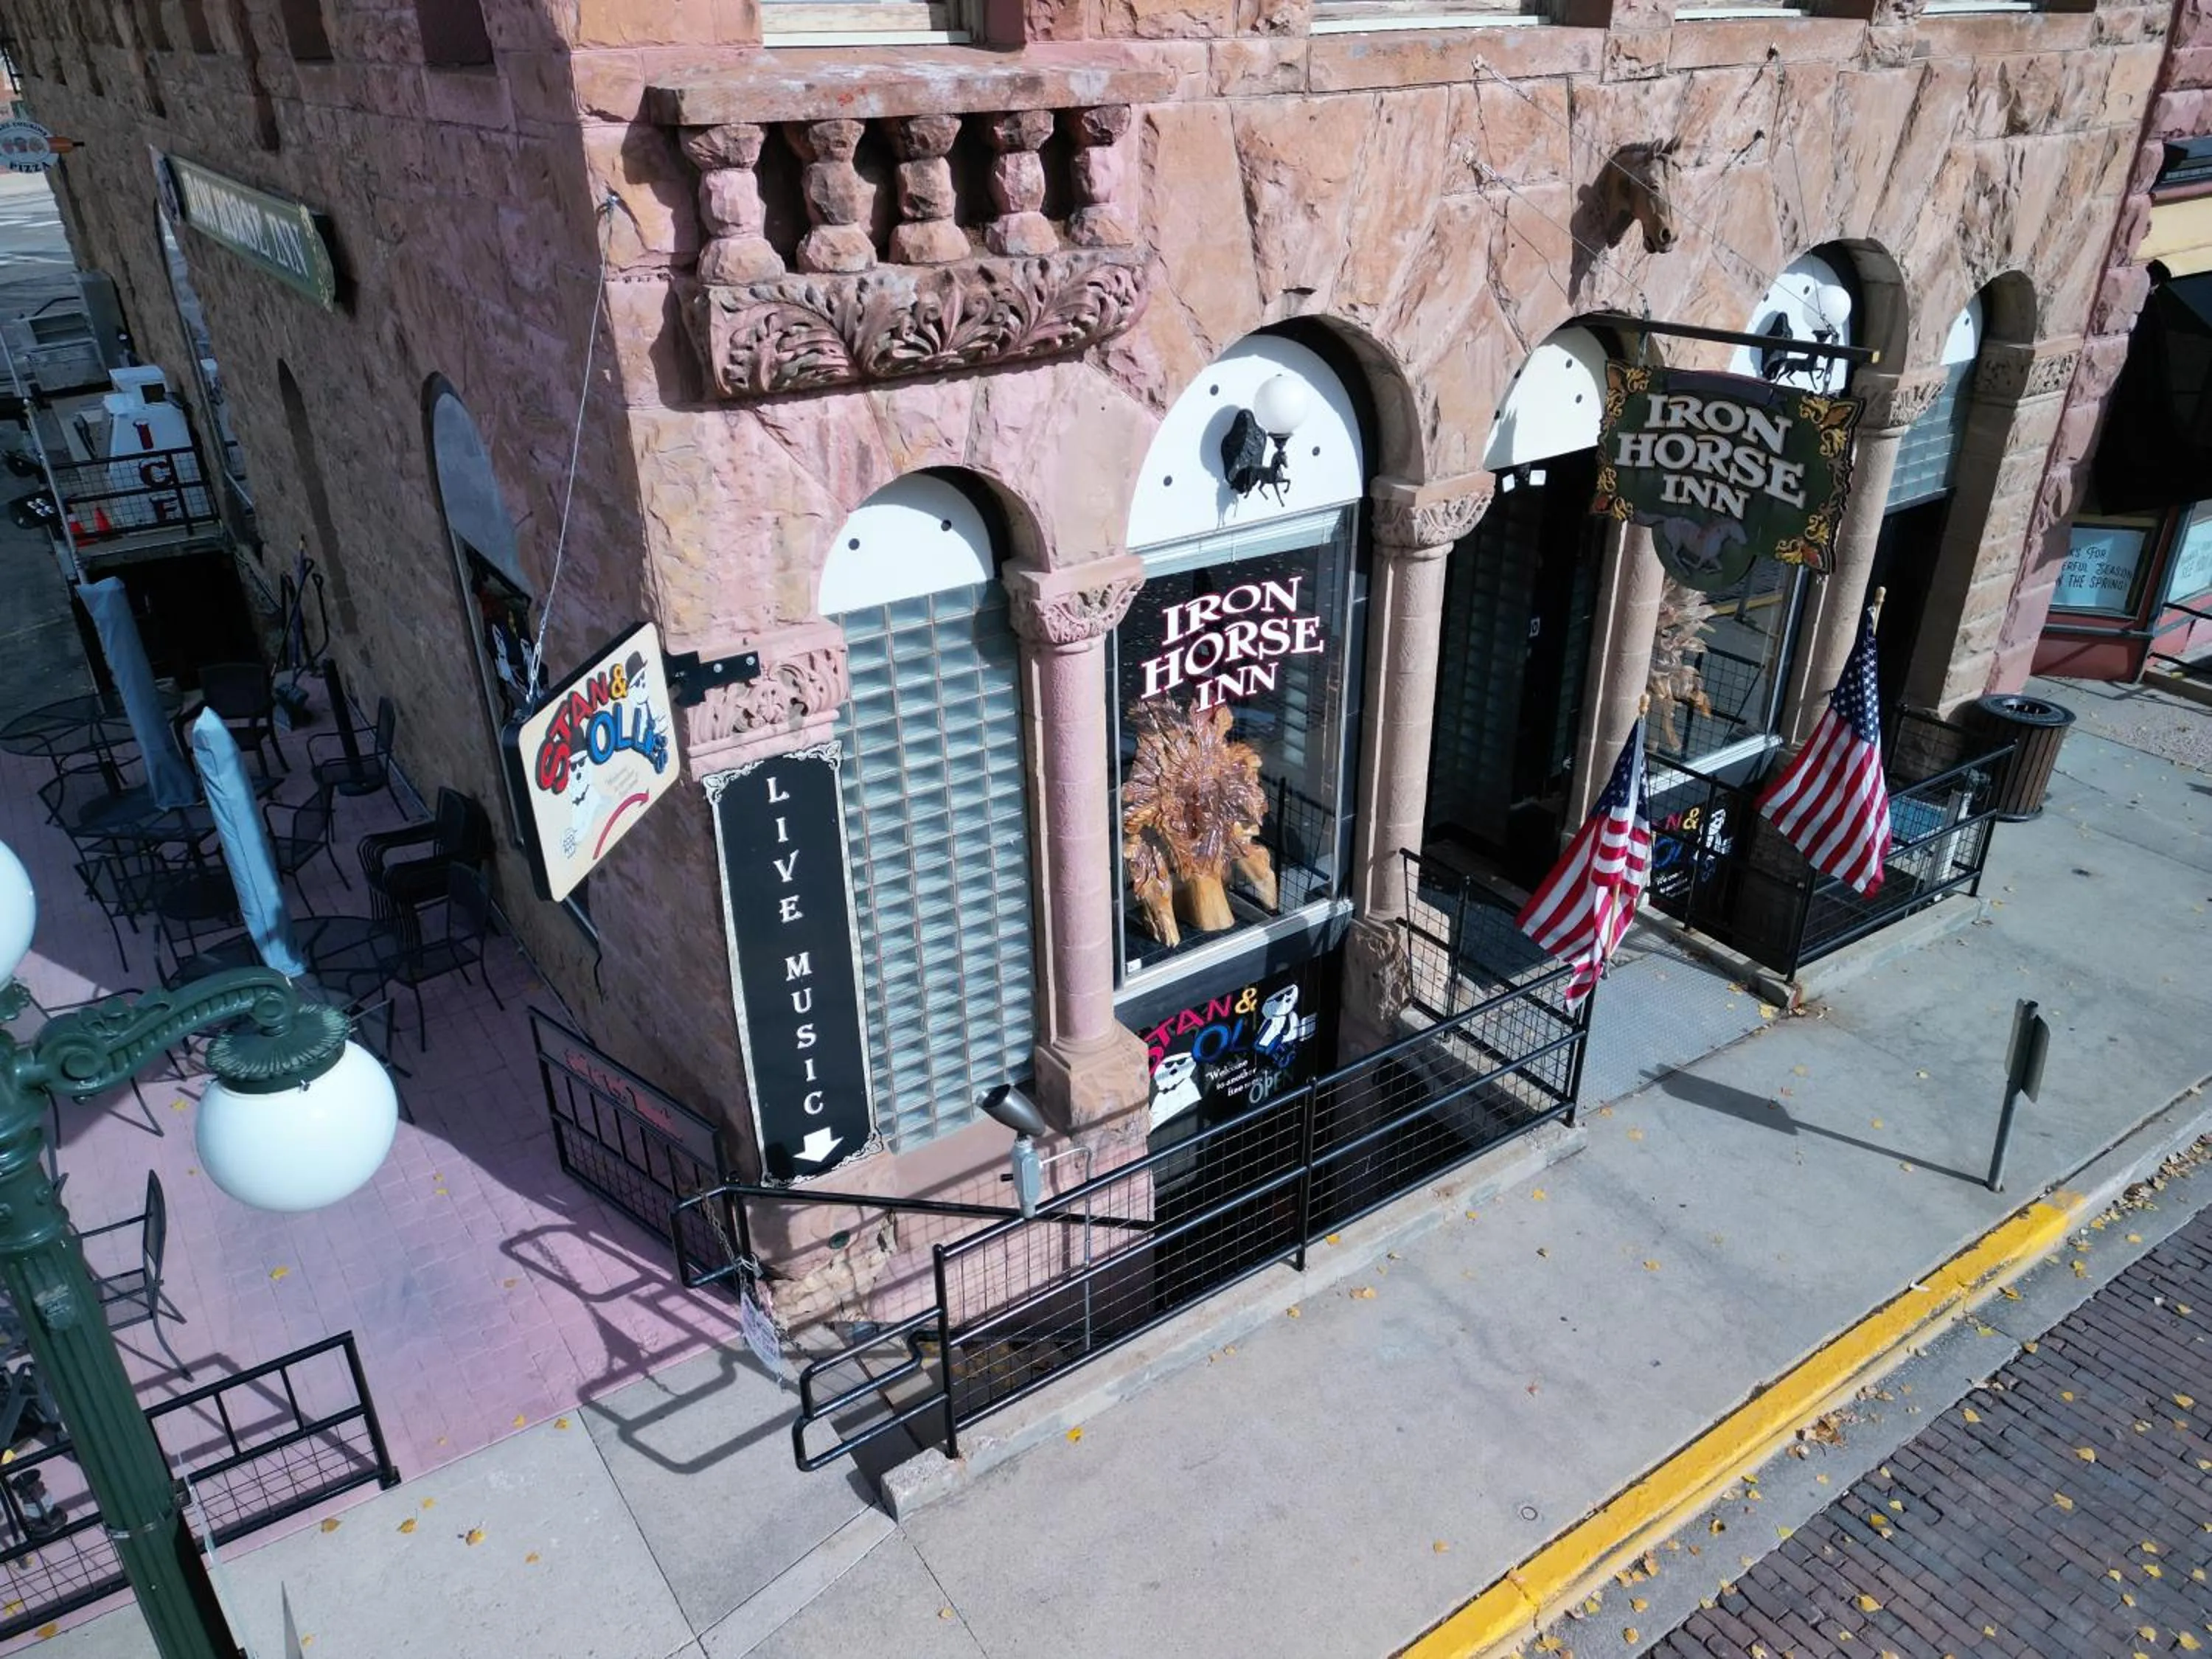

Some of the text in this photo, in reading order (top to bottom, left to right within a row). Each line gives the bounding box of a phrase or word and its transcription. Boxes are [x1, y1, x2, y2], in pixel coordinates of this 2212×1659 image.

[265, 212, 310, 278] INN
[1644, 393, 1793, 455] IRON
[1614, 432, 1806, 509] HORSE
[1660, 474, 1750, 519] INN
[2068, 574, 2086, 588] THE
[2086, 546, 2107, 559] FOR
[1161, 576, 1303, 646] IRON
[1141, 616, 1324, 699] HORSE
[1196, 662, 1279, 713] INN
[535, 663, 628, 795] STAN &
[766, 777, 824, 1115] LIVE MUSIC
[1234, 987, 1257, 1015] &
